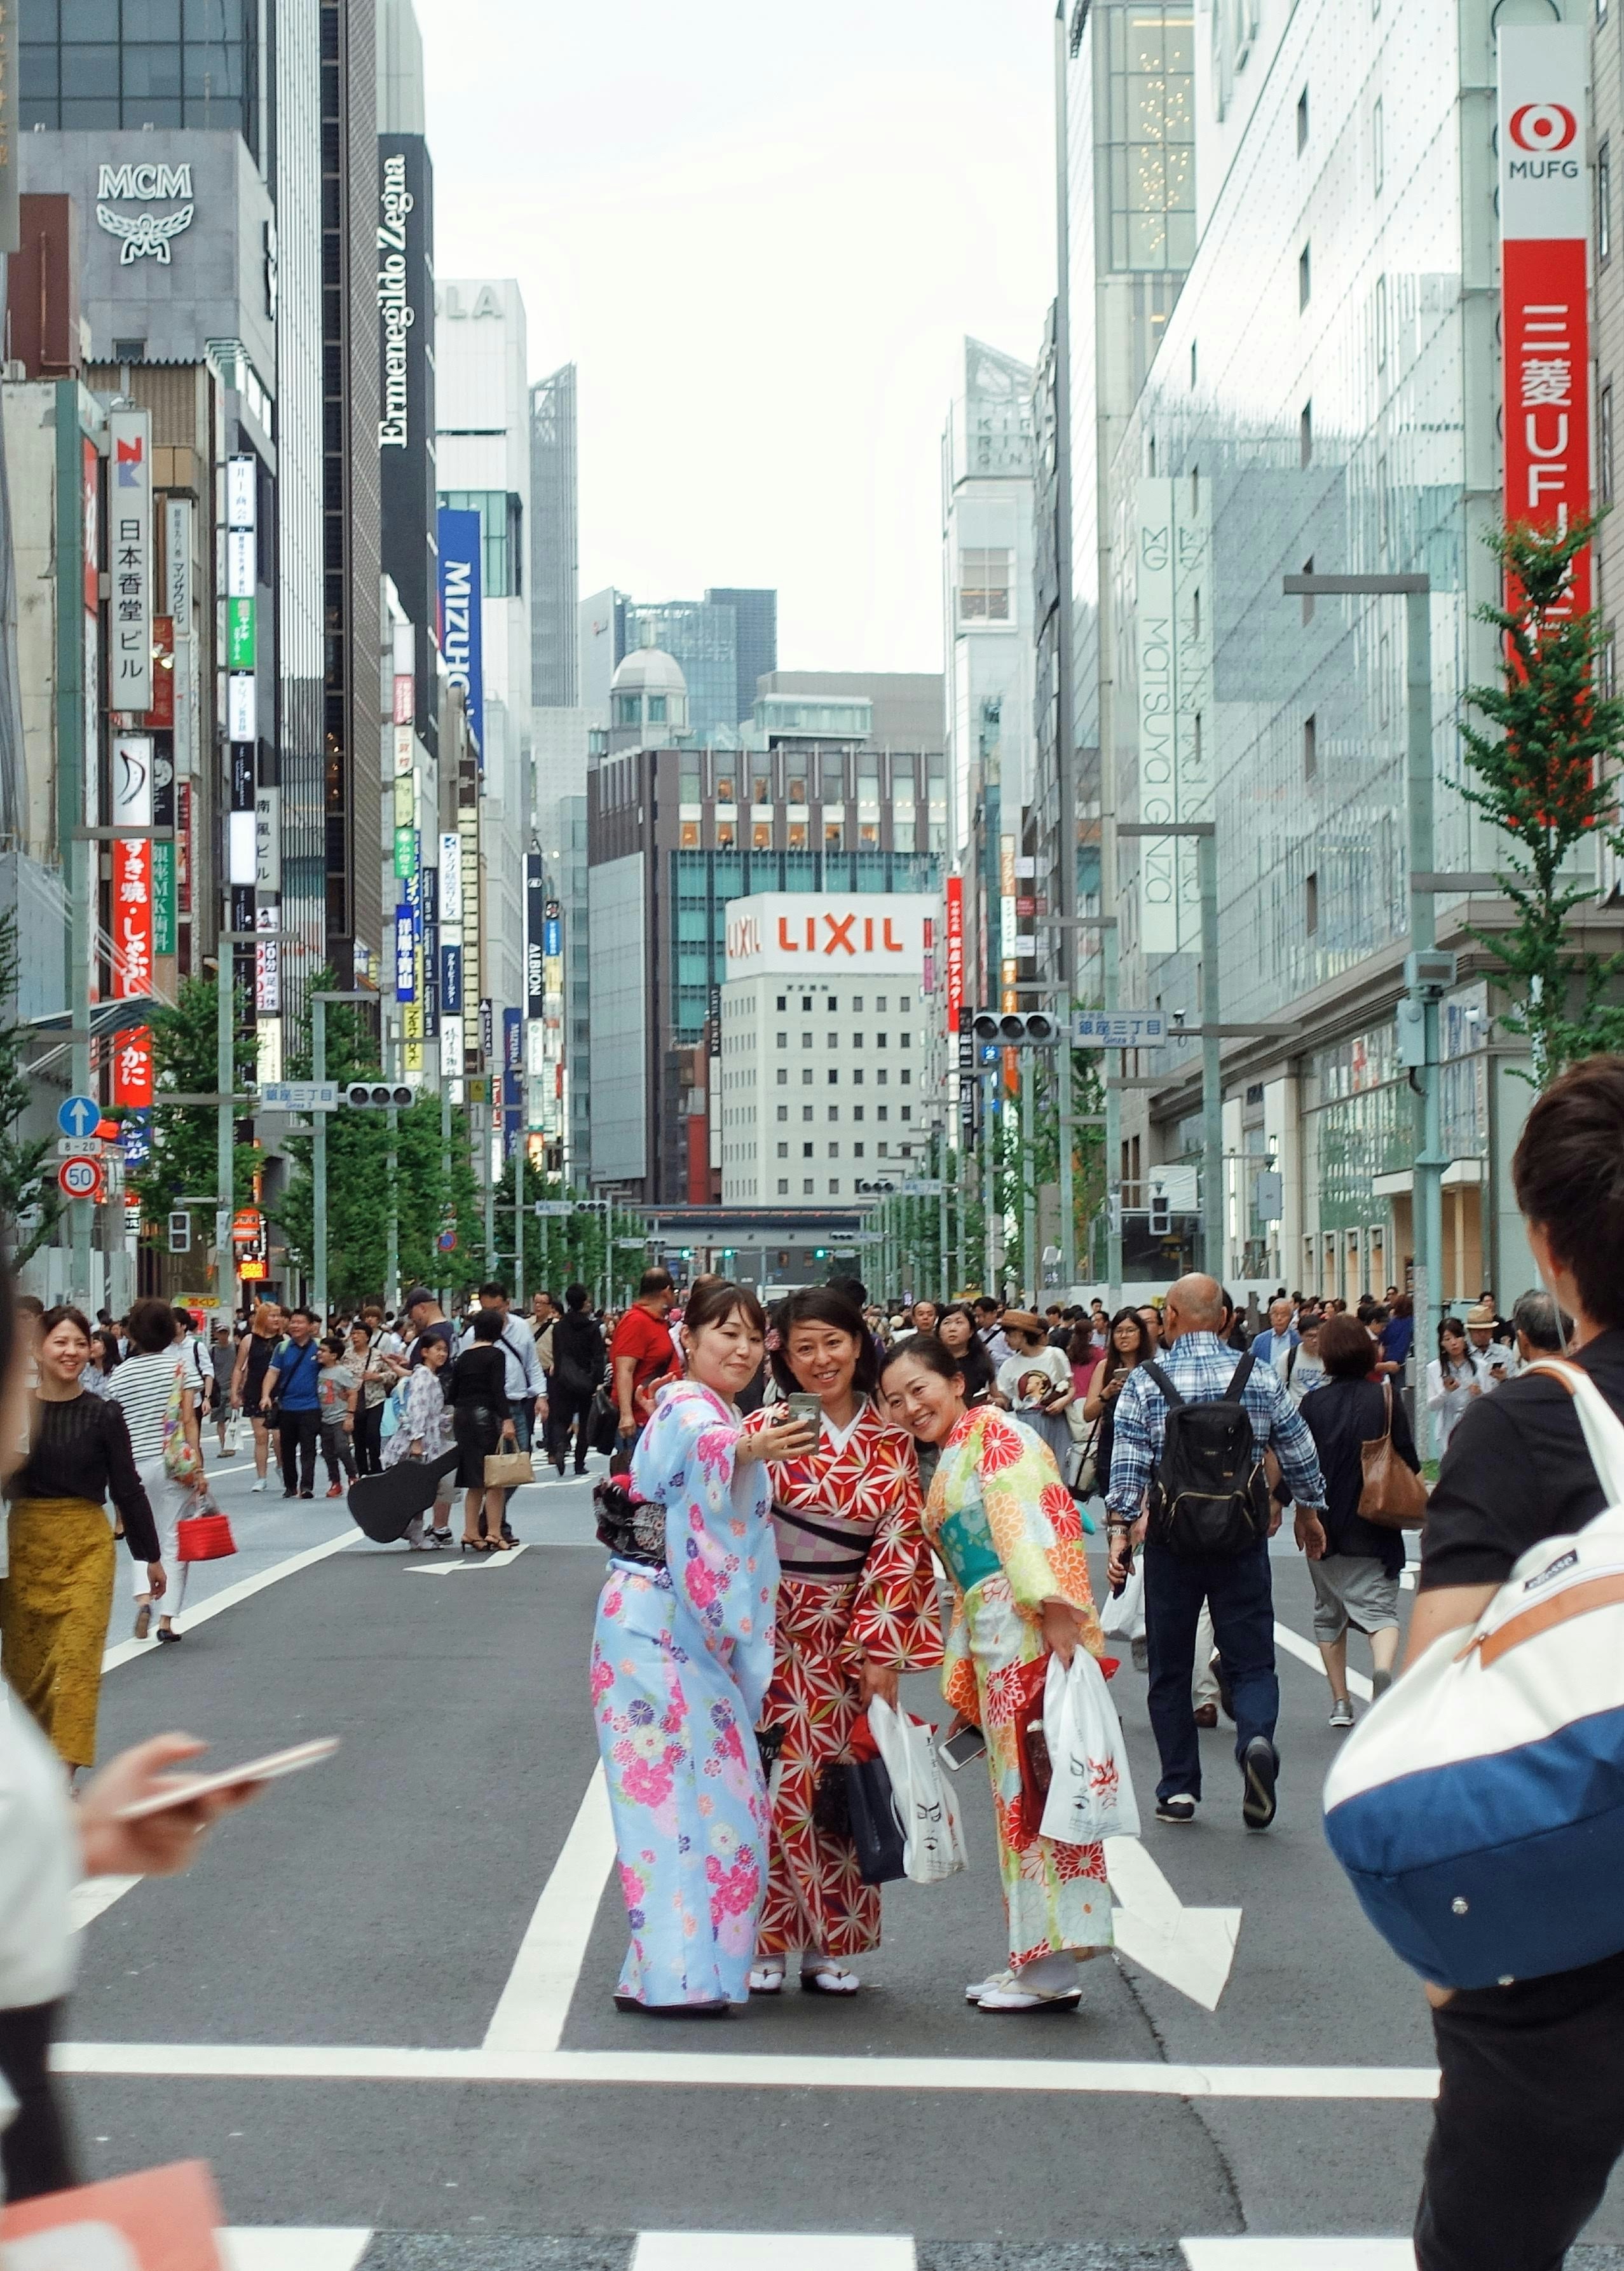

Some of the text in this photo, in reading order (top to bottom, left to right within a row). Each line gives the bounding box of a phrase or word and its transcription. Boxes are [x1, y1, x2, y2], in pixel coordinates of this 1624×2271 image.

[97, 163, 193, 200] MCM
[1509, 161, 1579, 179] MUFG
[376, 154, 414, 449] Ermenegildo Zegna
[433, 285, 505, 319] LA
[1521, 304, 1575, 655] 三菱UFJ
[118, 519, 143, 679] 日本香堂ビル
[1143, 798, 1173, 904] GNZA
[728, 915, 761, 959] LIXIL
[778, 912, 903, 955] LIXIL
[529, 942, 542, 997] ALBION
[1079, 1020, 1161, 1035] 銀座三丁目
[1102, 1035, 1127, 1044] Ginza
[121, 1046, 148, 1086] かに
[266, 1088, 332, 1101] 銀座三丁目
[69, 1168, 92, 1186] 50
